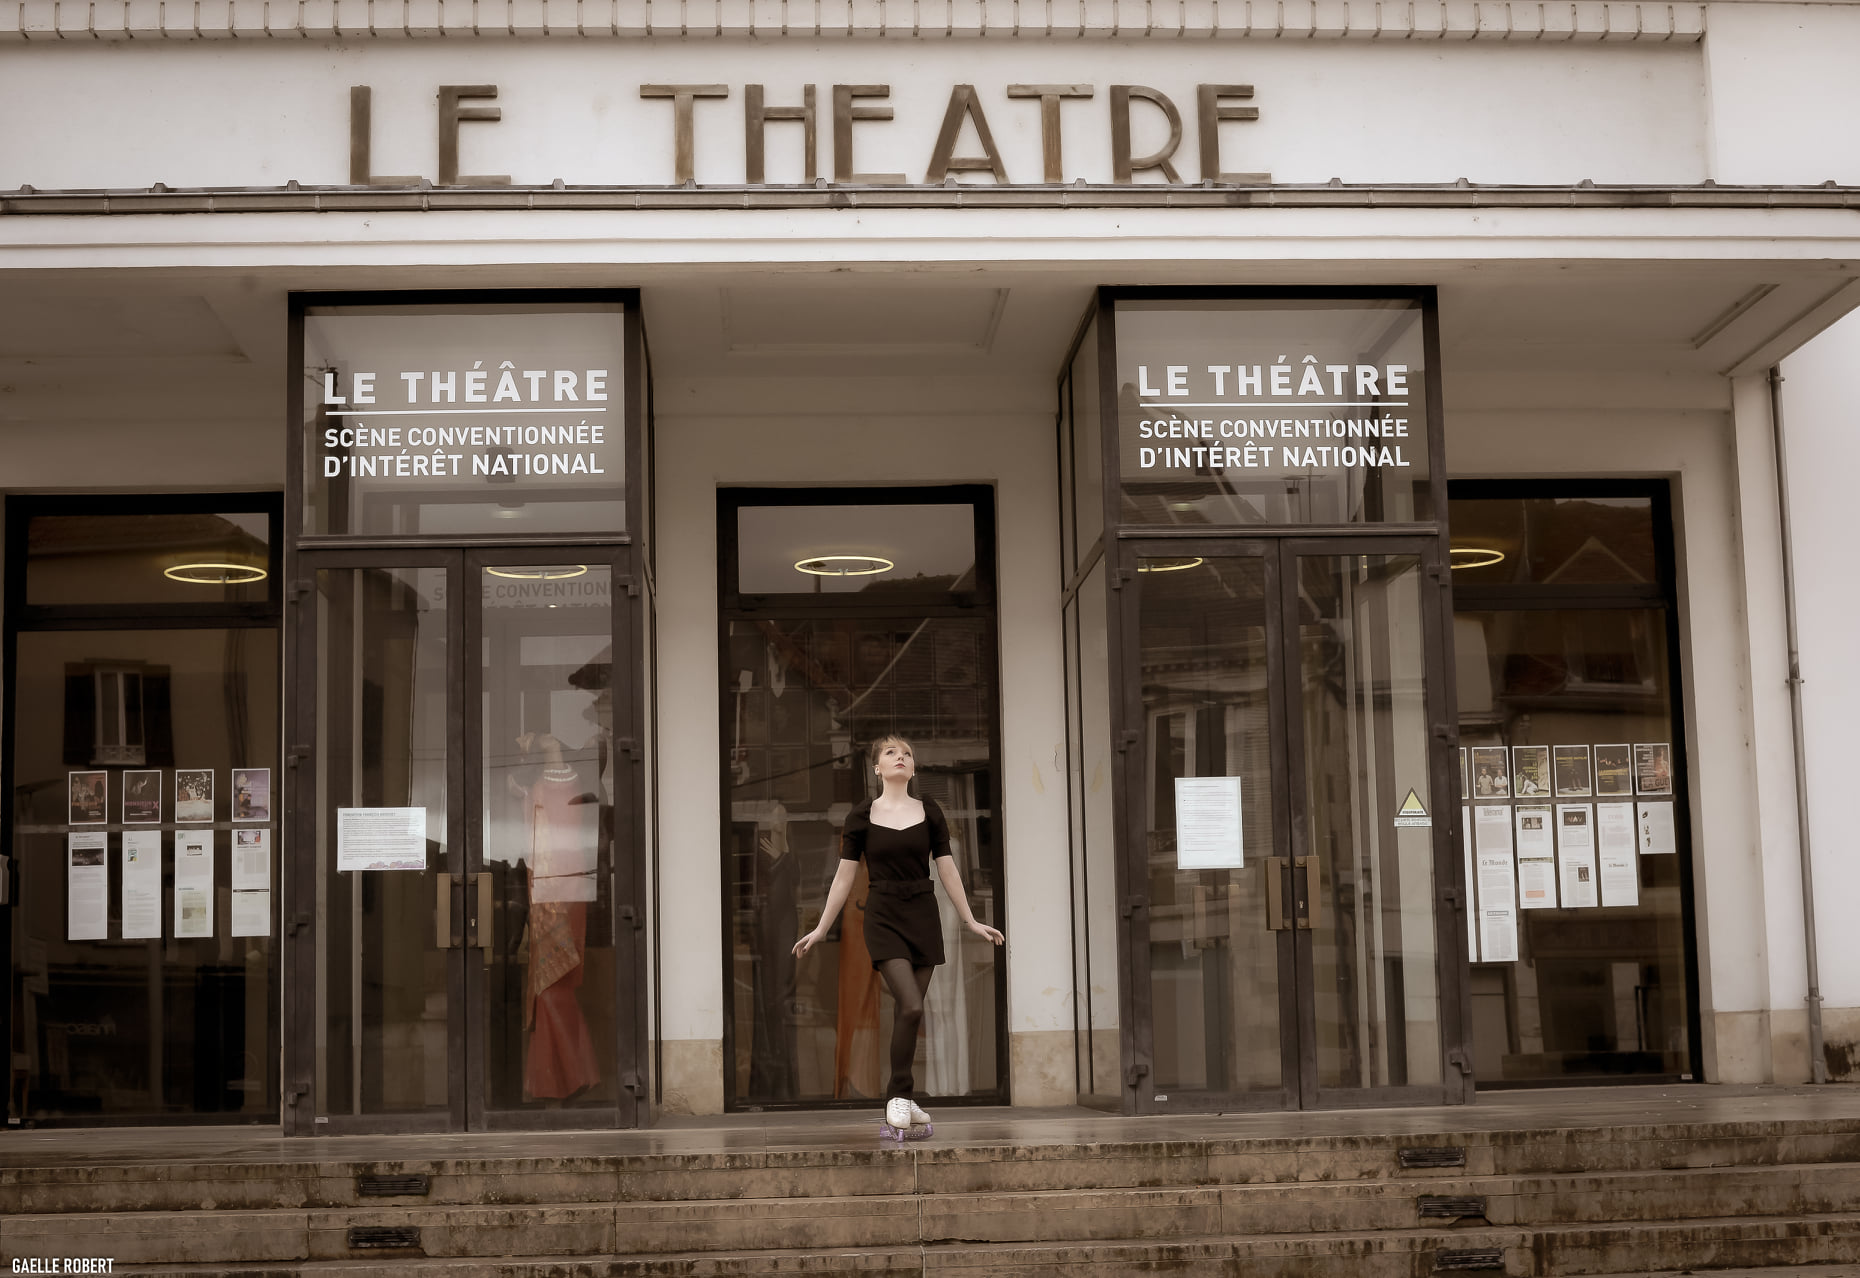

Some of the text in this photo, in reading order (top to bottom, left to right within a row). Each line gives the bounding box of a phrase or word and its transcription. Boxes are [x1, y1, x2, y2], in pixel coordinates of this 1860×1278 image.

[350, 83, 1271, 185] LE THEATRE
[324, 360, 608, 404] LE THÉÂTRE
[1138, 355, 1409, 396] LE THÉÂTRE
[324, 420, 604, 447] SCÈNE CONVENTIONNÉE
[1139, 414, 1409, 438] SCÈNE CONVENTIONNÉE
[324, 448, 605, 477] D'INTÉRÊT NATIONAL
[1139, 441, 1410, 468] D'INTÉRÊT NATIONAL
[495, 581, 612, 599] CONVENTION
